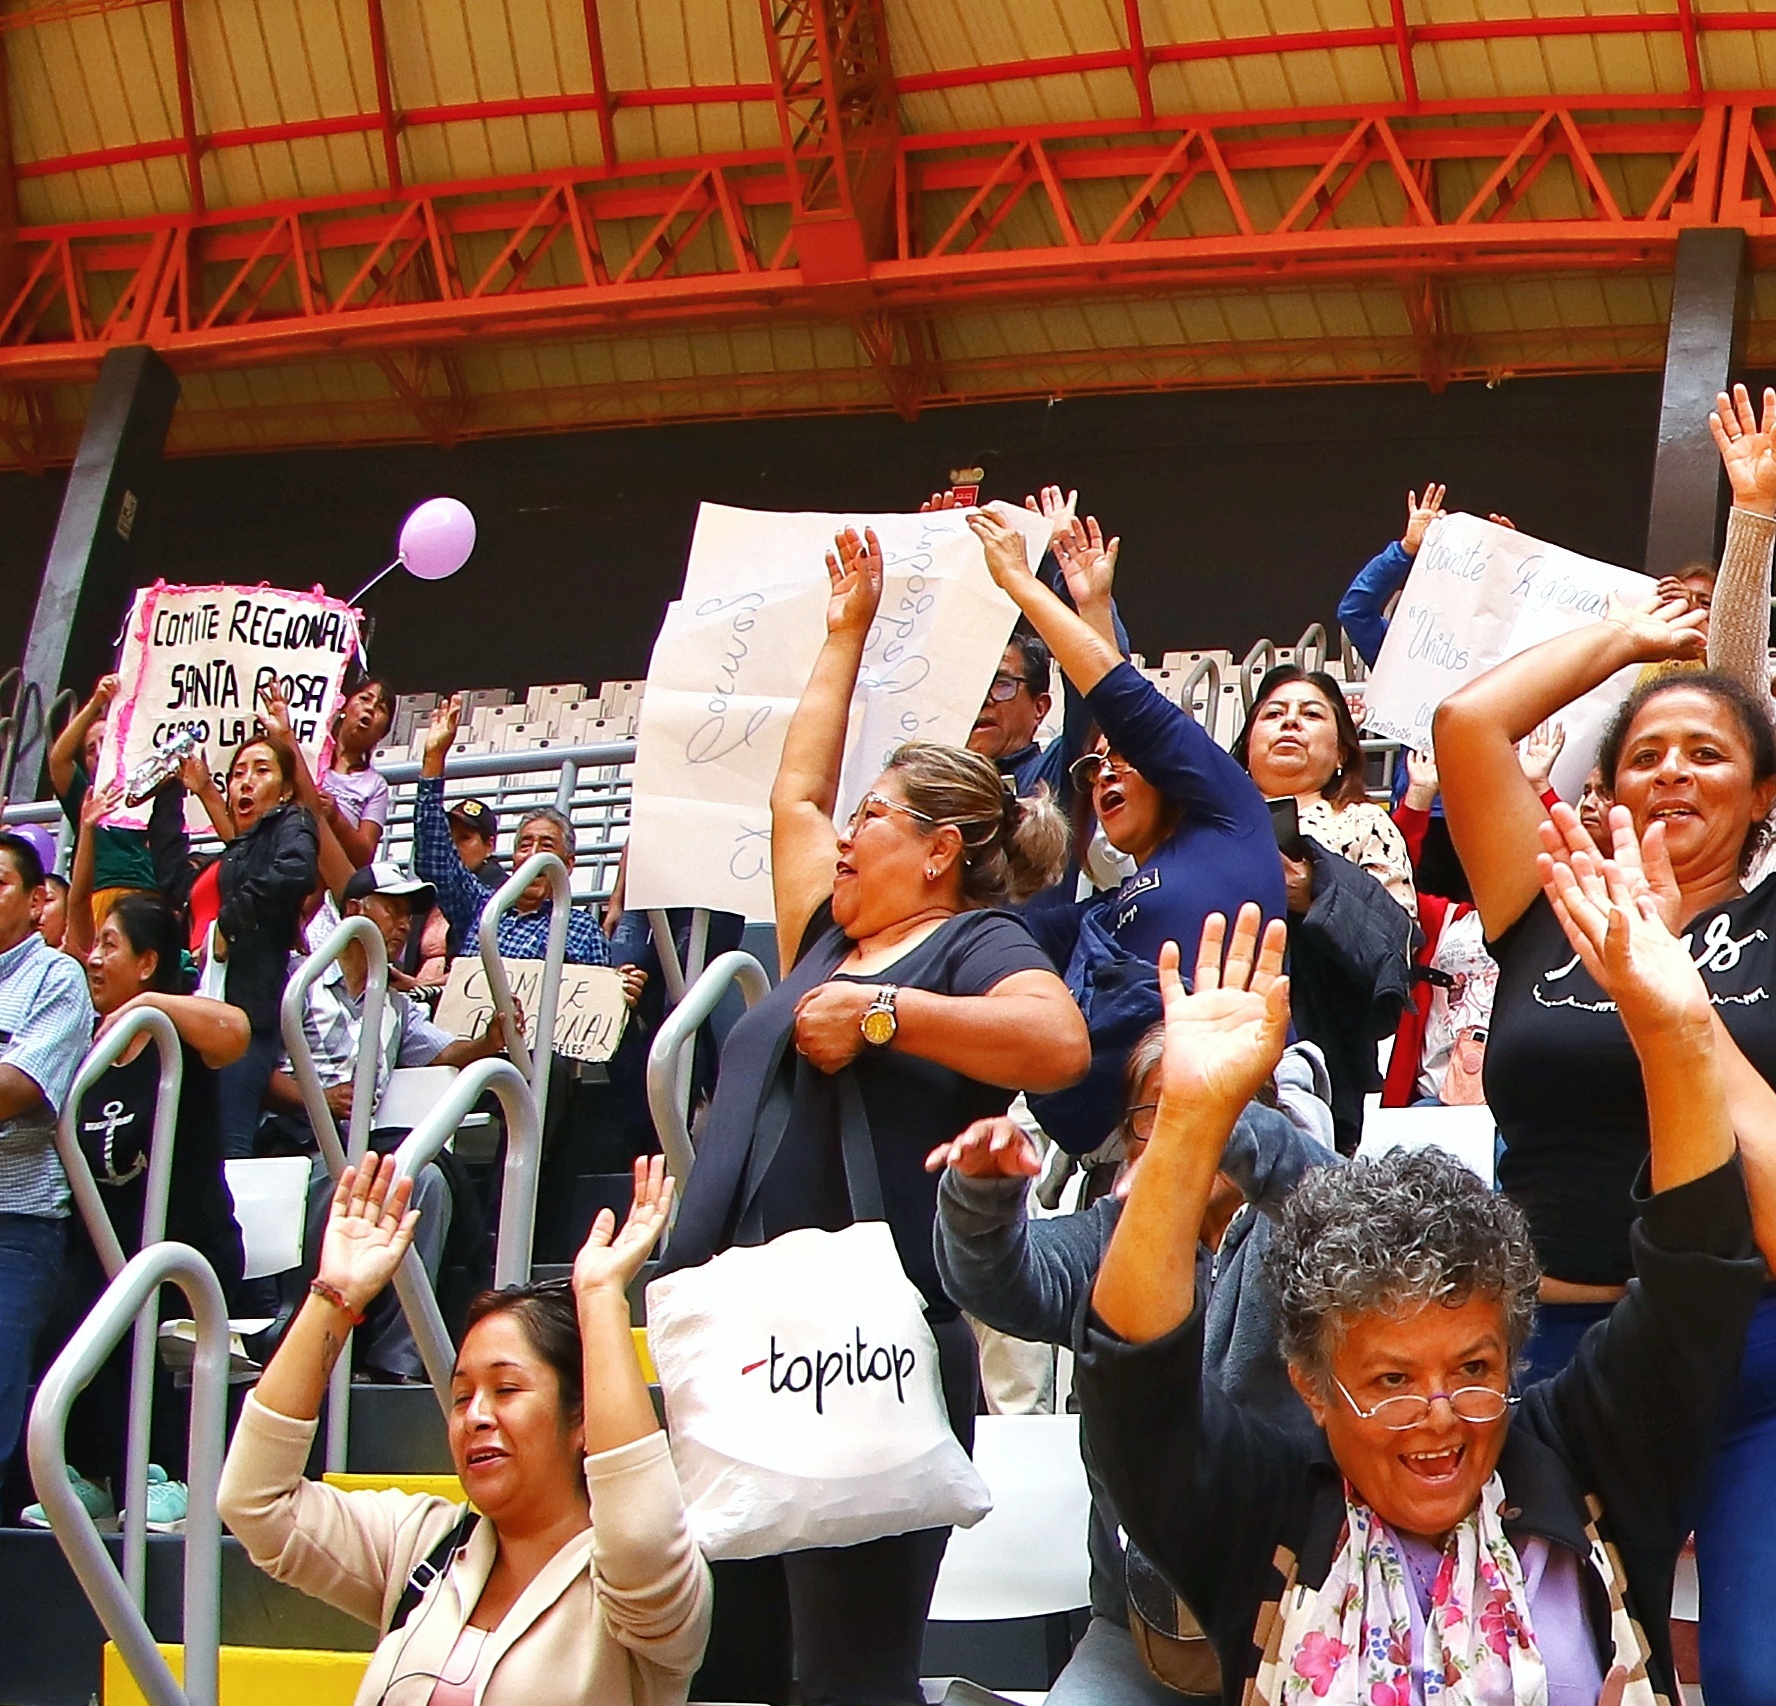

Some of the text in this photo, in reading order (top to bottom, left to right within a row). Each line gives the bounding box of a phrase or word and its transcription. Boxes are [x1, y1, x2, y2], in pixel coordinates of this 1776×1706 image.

[153, 599, 348, 654] COMITE REGIONAL
[167, 659, 329, 714] SANTA ROSA
[219, 718, 244, 747] LA
[769, 1325, 917, 1416] topitop
